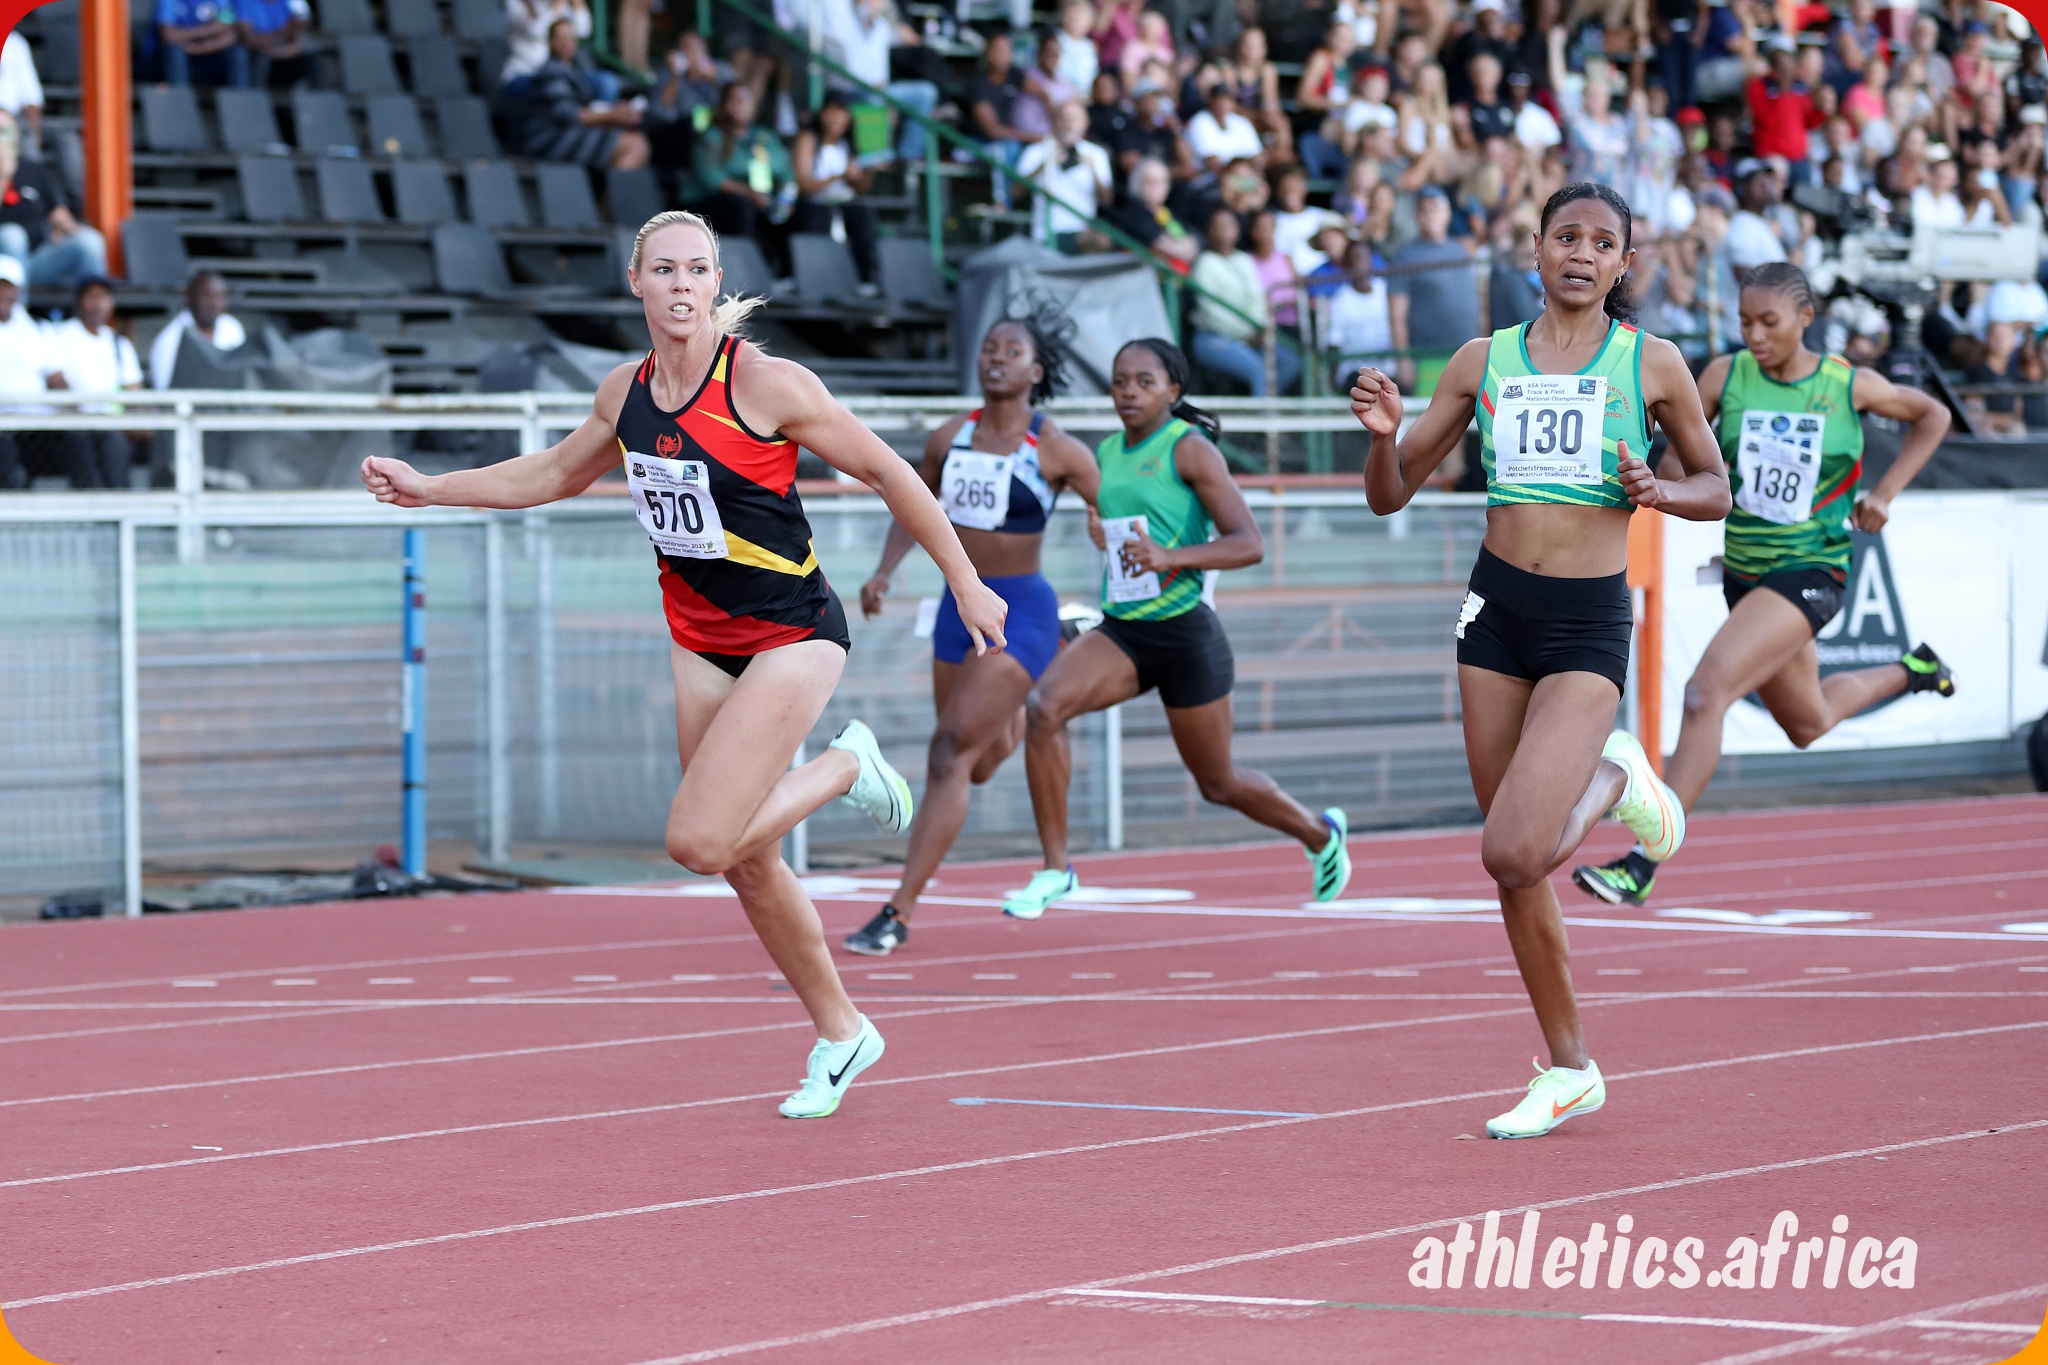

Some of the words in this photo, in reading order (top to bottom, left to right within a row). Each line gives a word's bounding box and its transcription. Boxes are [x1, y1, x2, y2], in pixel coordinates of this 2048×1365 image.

[1515, 409, 1583, 455] 130
[954, 478, 996, 510] 265
[1753, 465, 1801, 503] 138
[643, 489, 704, 535] 570
